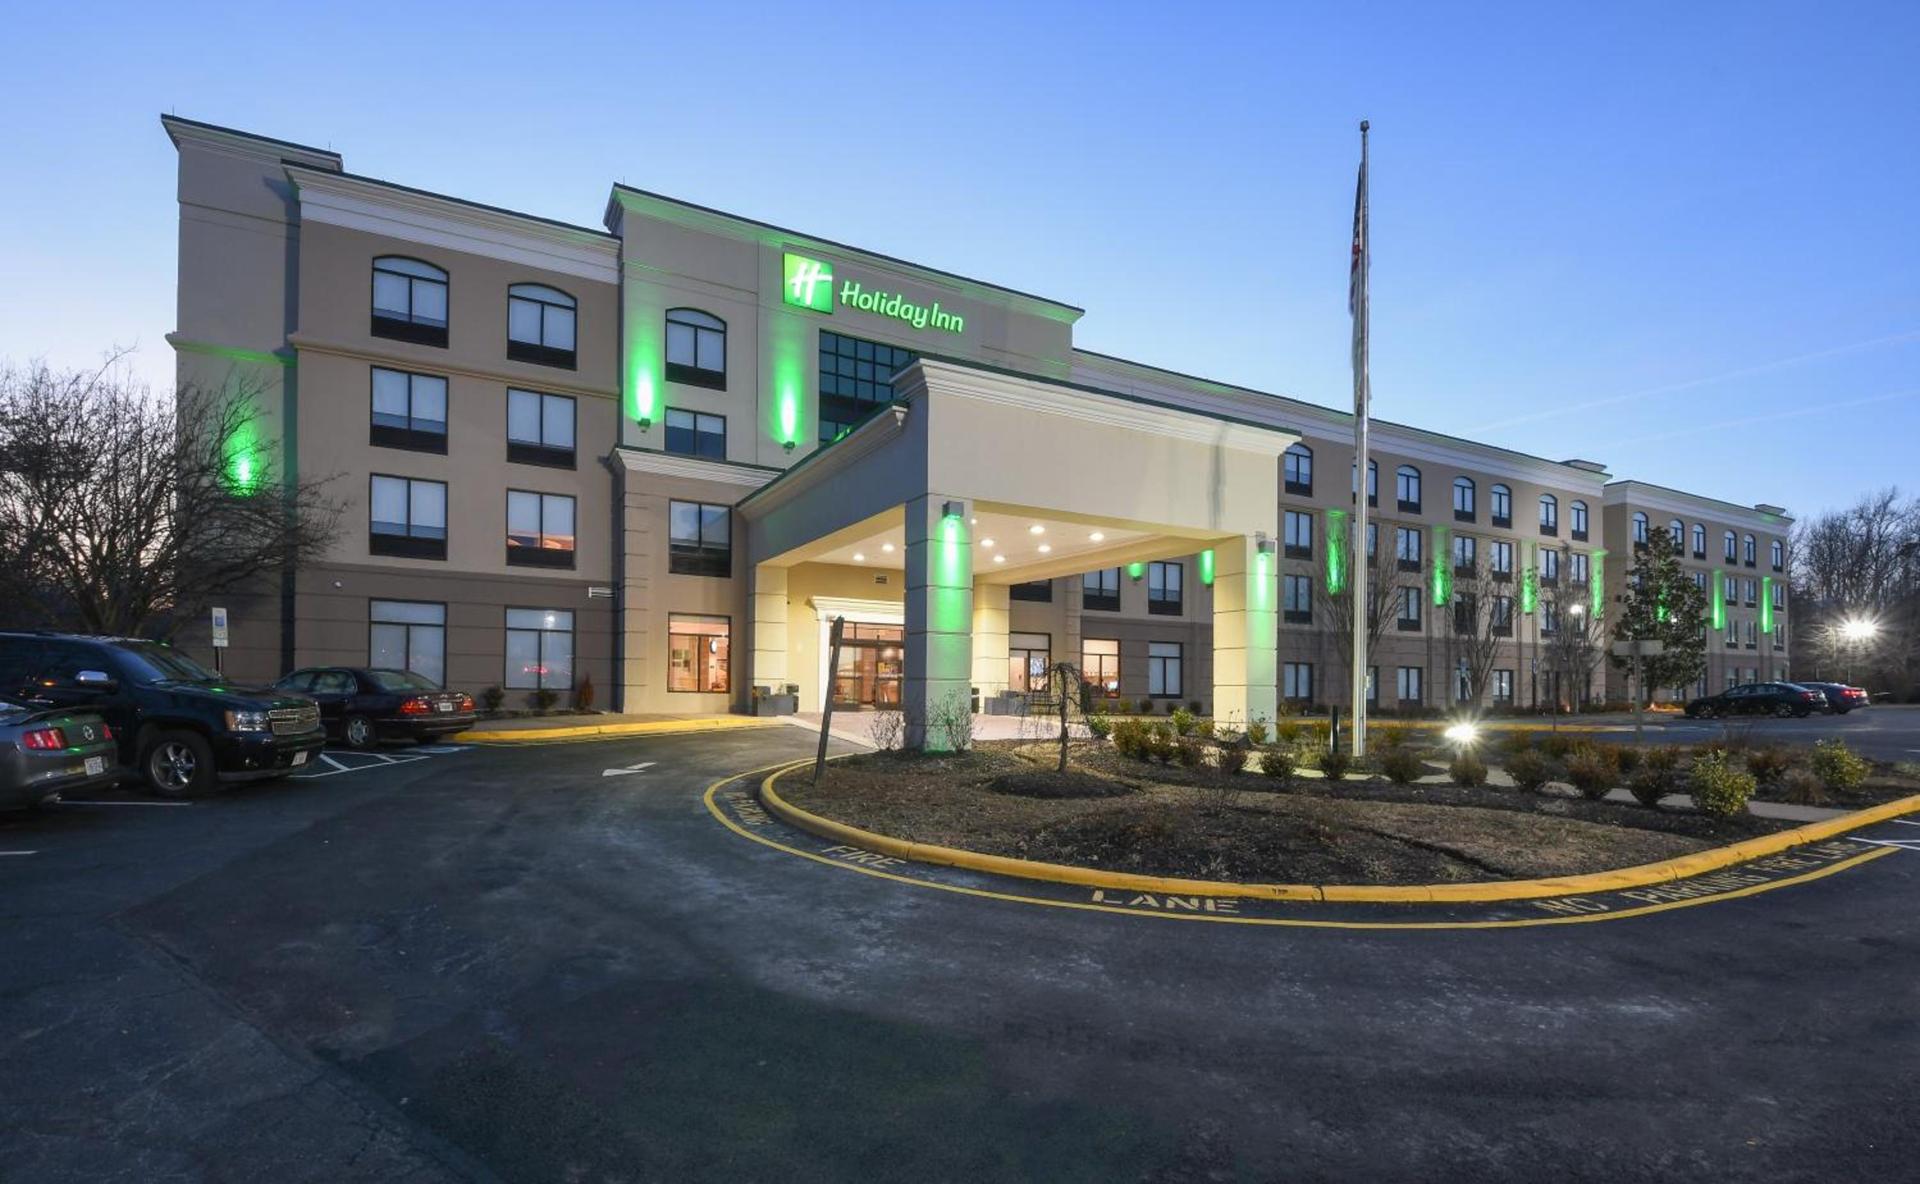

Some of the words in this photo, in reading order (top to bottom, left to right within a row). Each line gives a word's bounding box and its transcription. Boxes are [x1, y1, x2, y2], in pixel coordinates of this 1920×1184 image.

[840, 280, 929, 329] Holiday
[930, 302, 964, 333] Inn
[821, 845, 907, 869] FIRE
[1092, 889, 1241, 914] LANE
